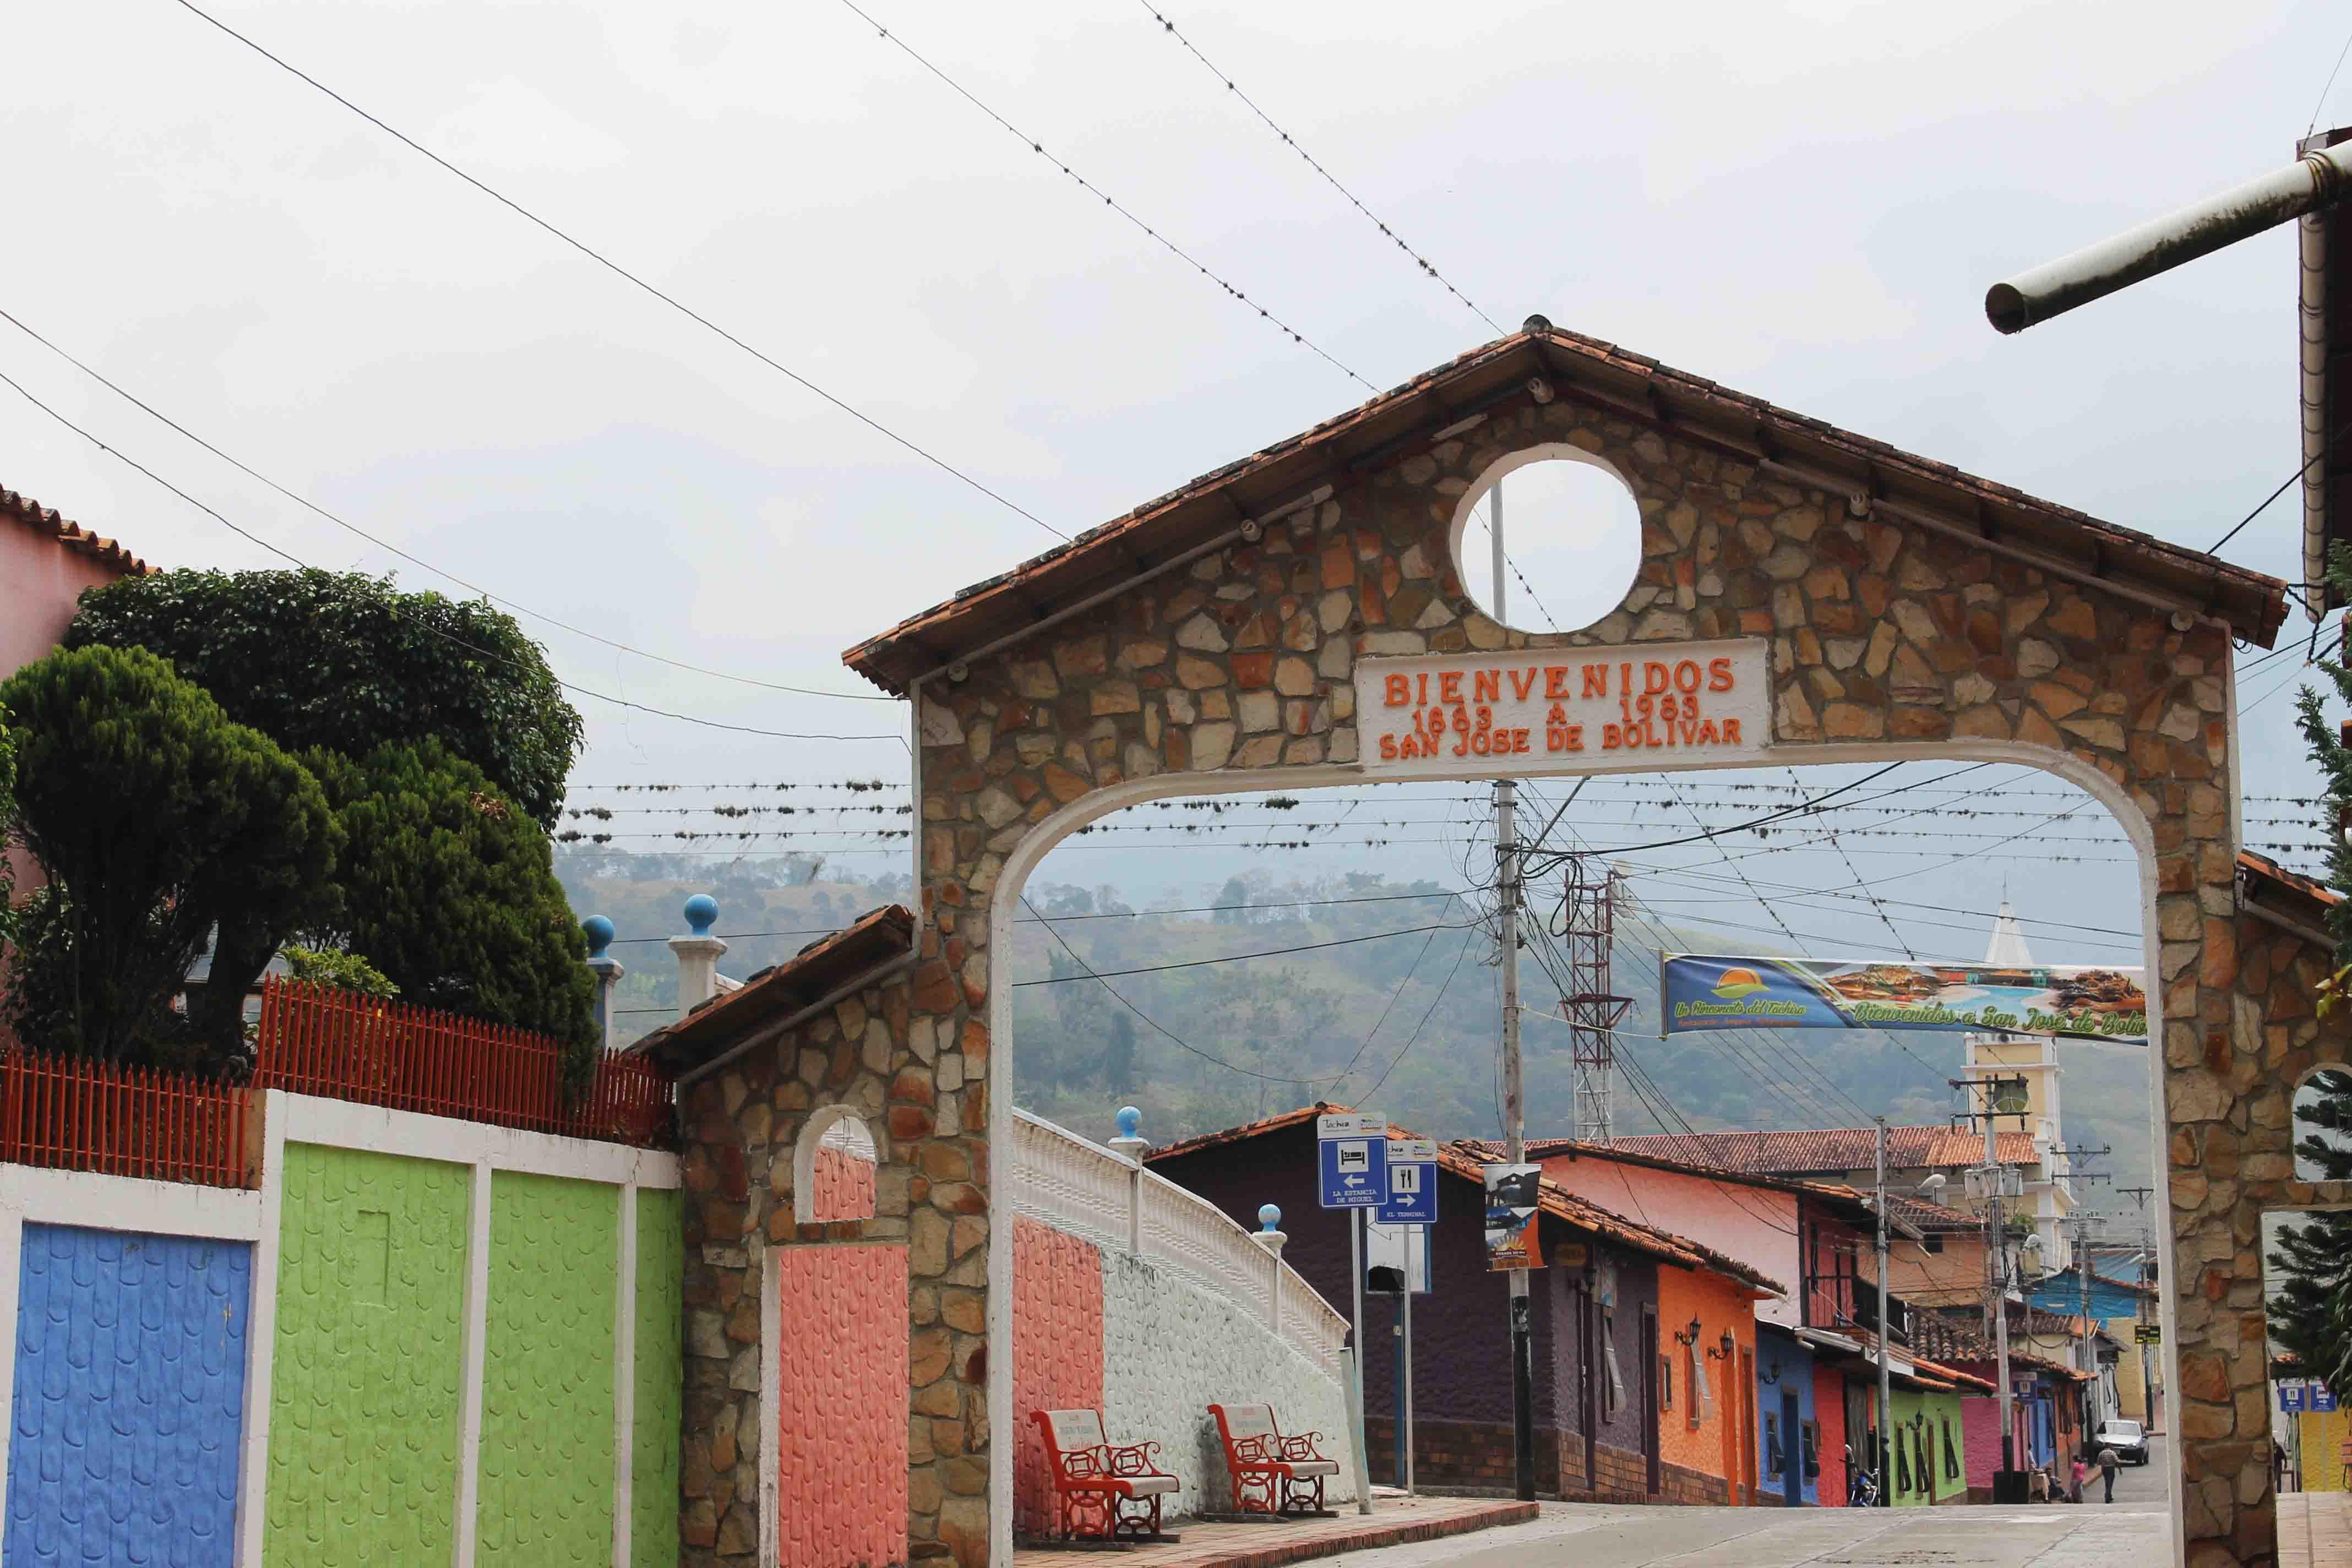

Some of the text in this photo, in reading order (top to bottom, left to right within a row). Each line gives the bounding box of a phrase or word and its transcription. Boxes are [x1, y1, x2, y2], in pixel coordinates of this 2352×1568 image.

[1384, 658, 1734, 706] BIENVENIDOS
[1412, 694, 1700, 733] 1883 A 1983
[1379, 718, 1741, 759] SAN JOSE DE BOLIVAR
[1853, 1001, 1956, 1024] Bienvenidos
[1962, 1011, 1977, 1024] a
[1982, 1005, 2018, 1027] San
[2071, 1009, 2096, 1032] de
